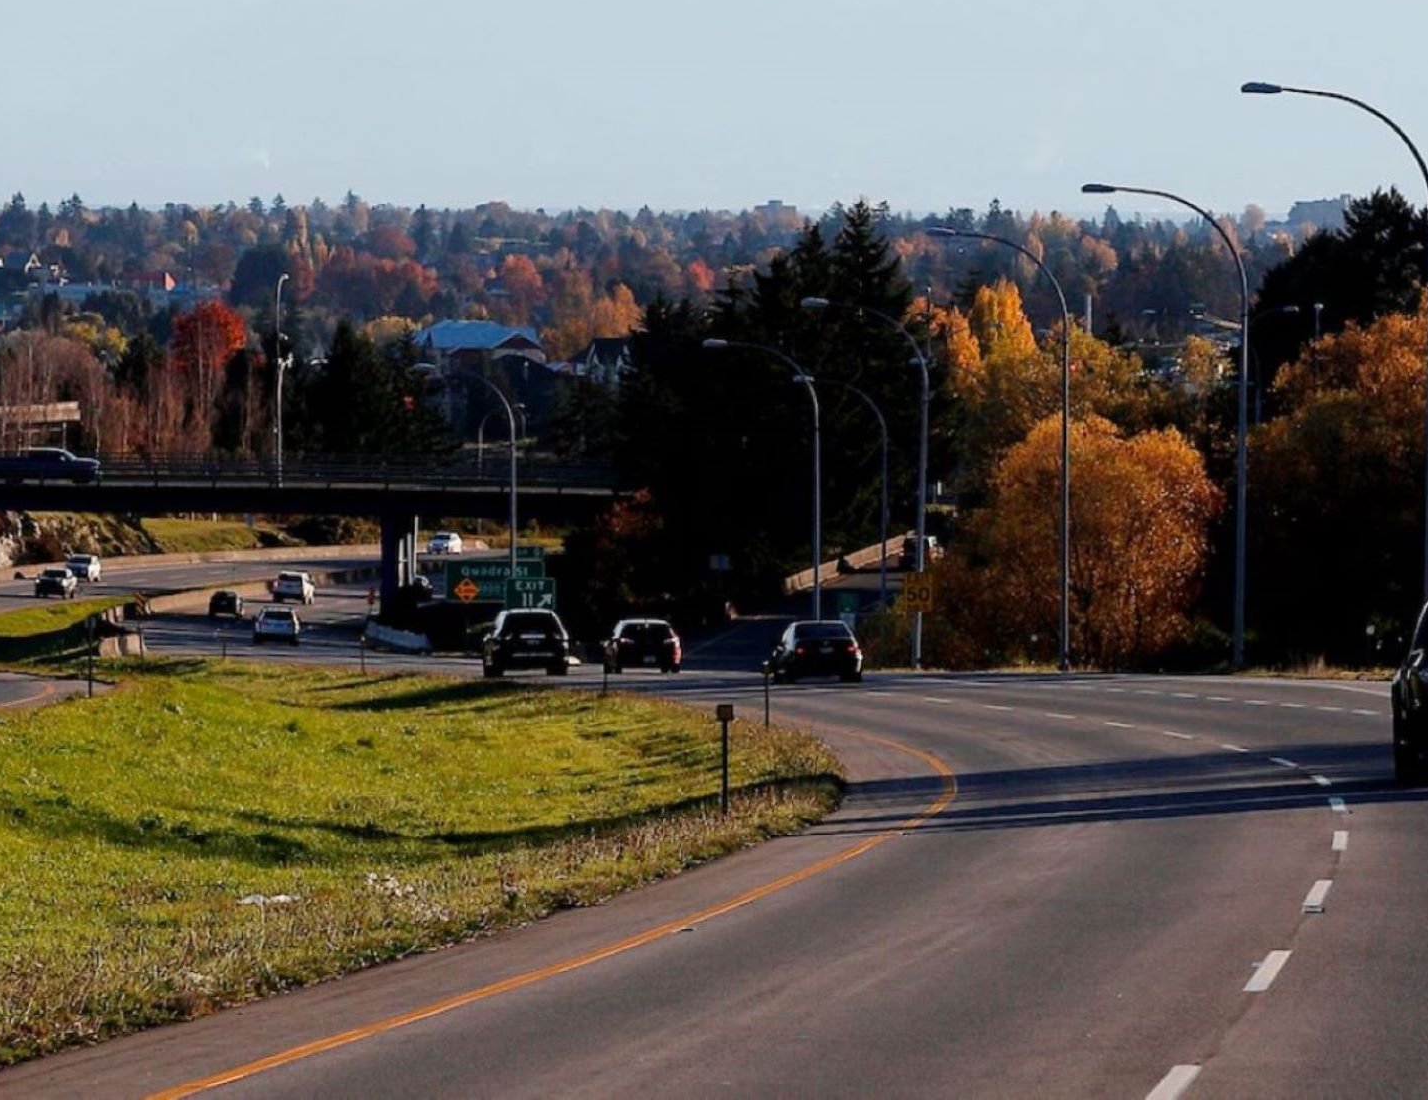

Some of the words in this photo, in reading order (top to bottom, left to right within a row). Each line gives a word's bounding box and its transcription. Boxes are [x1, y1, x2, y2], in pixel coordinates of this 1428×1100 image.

[460, 565, 511, 577] Quadra
[515, 580, 545, 591] EXIT
[522, 592, 534, 607] 11
[907, 586, 930, 602] 50
